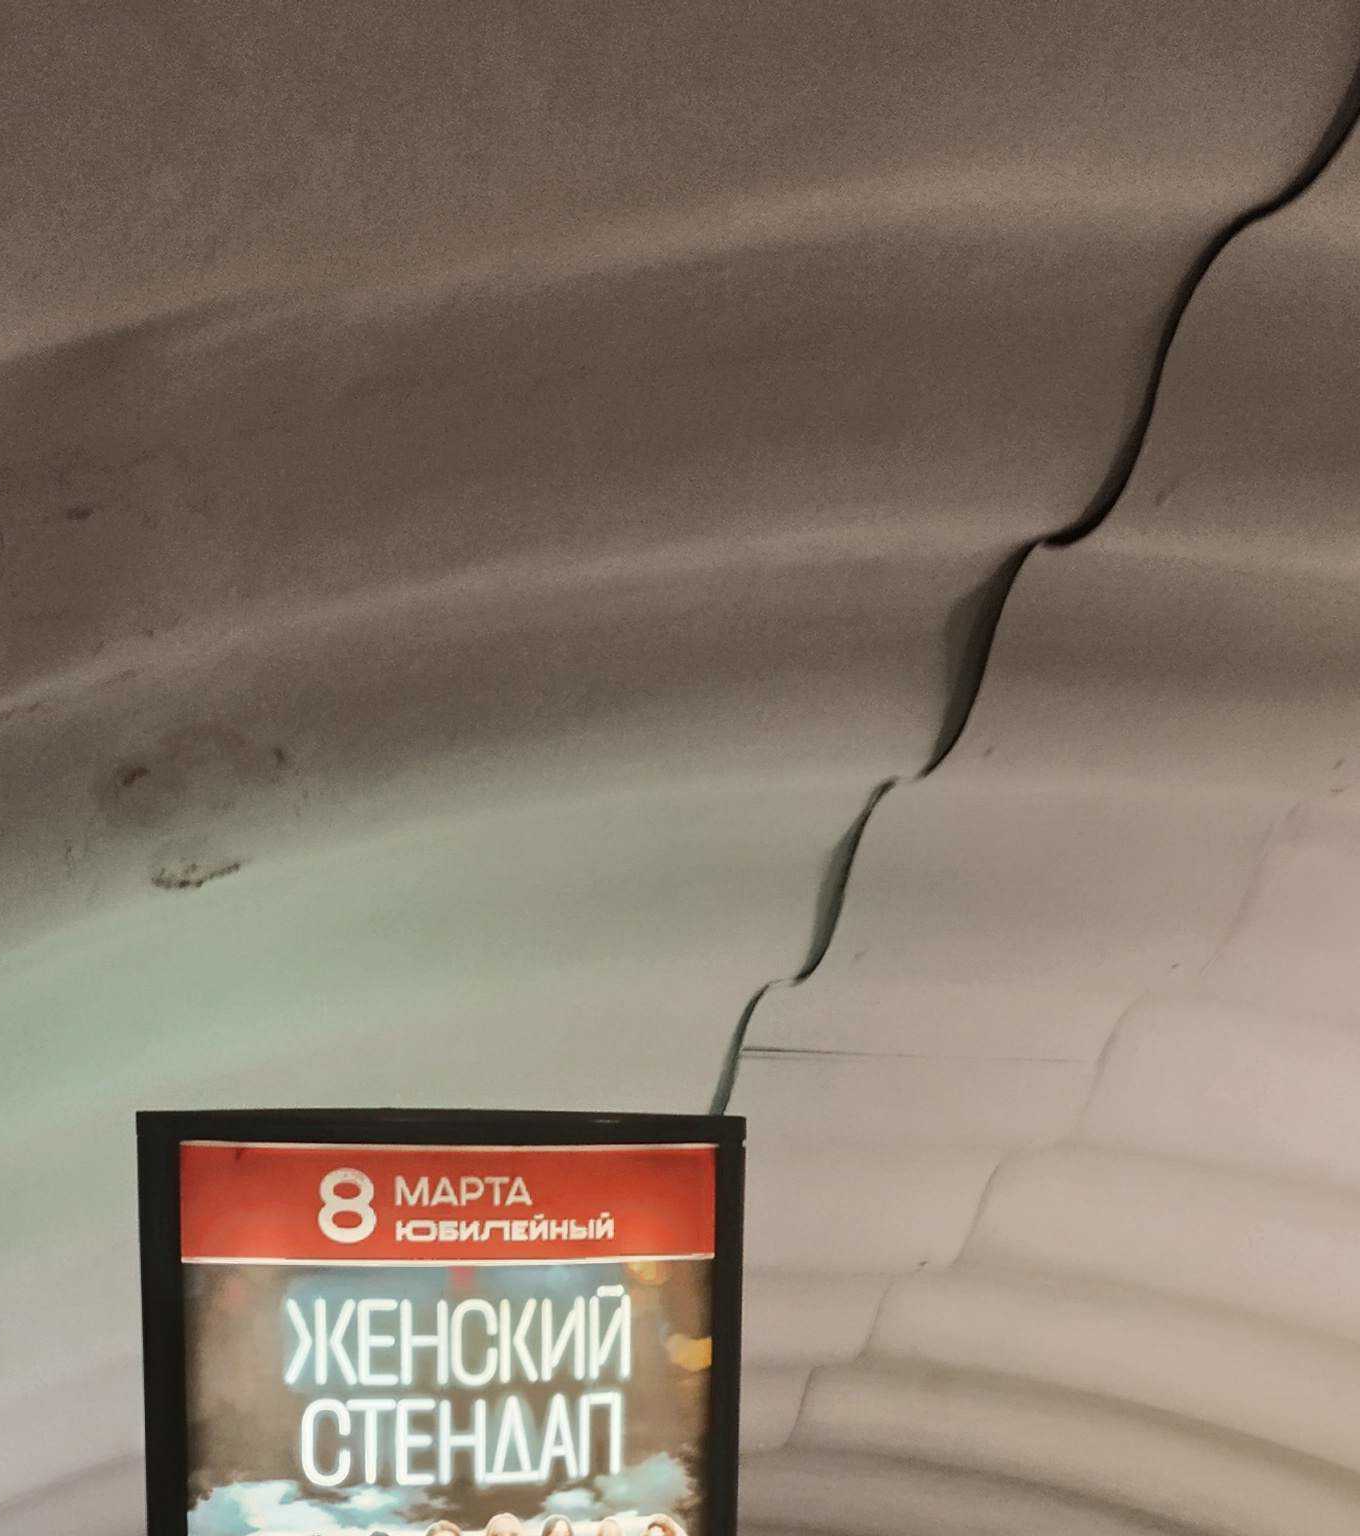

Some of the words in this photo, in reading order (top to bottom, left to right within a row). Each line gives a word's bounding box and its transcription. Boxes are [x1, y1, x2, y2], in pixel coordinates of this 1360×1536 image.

[318, 1168, 377, 1243] 8
[395, 1175, 532, 1207] МАРТА
[395, 1212, 615, 1243] ЮБИЛЕЙНЫЙ
[284, 1284, 632, 1387] ЖЕНСКИЙ
[300, 1391, 623, 1488] СТЕНДАП
